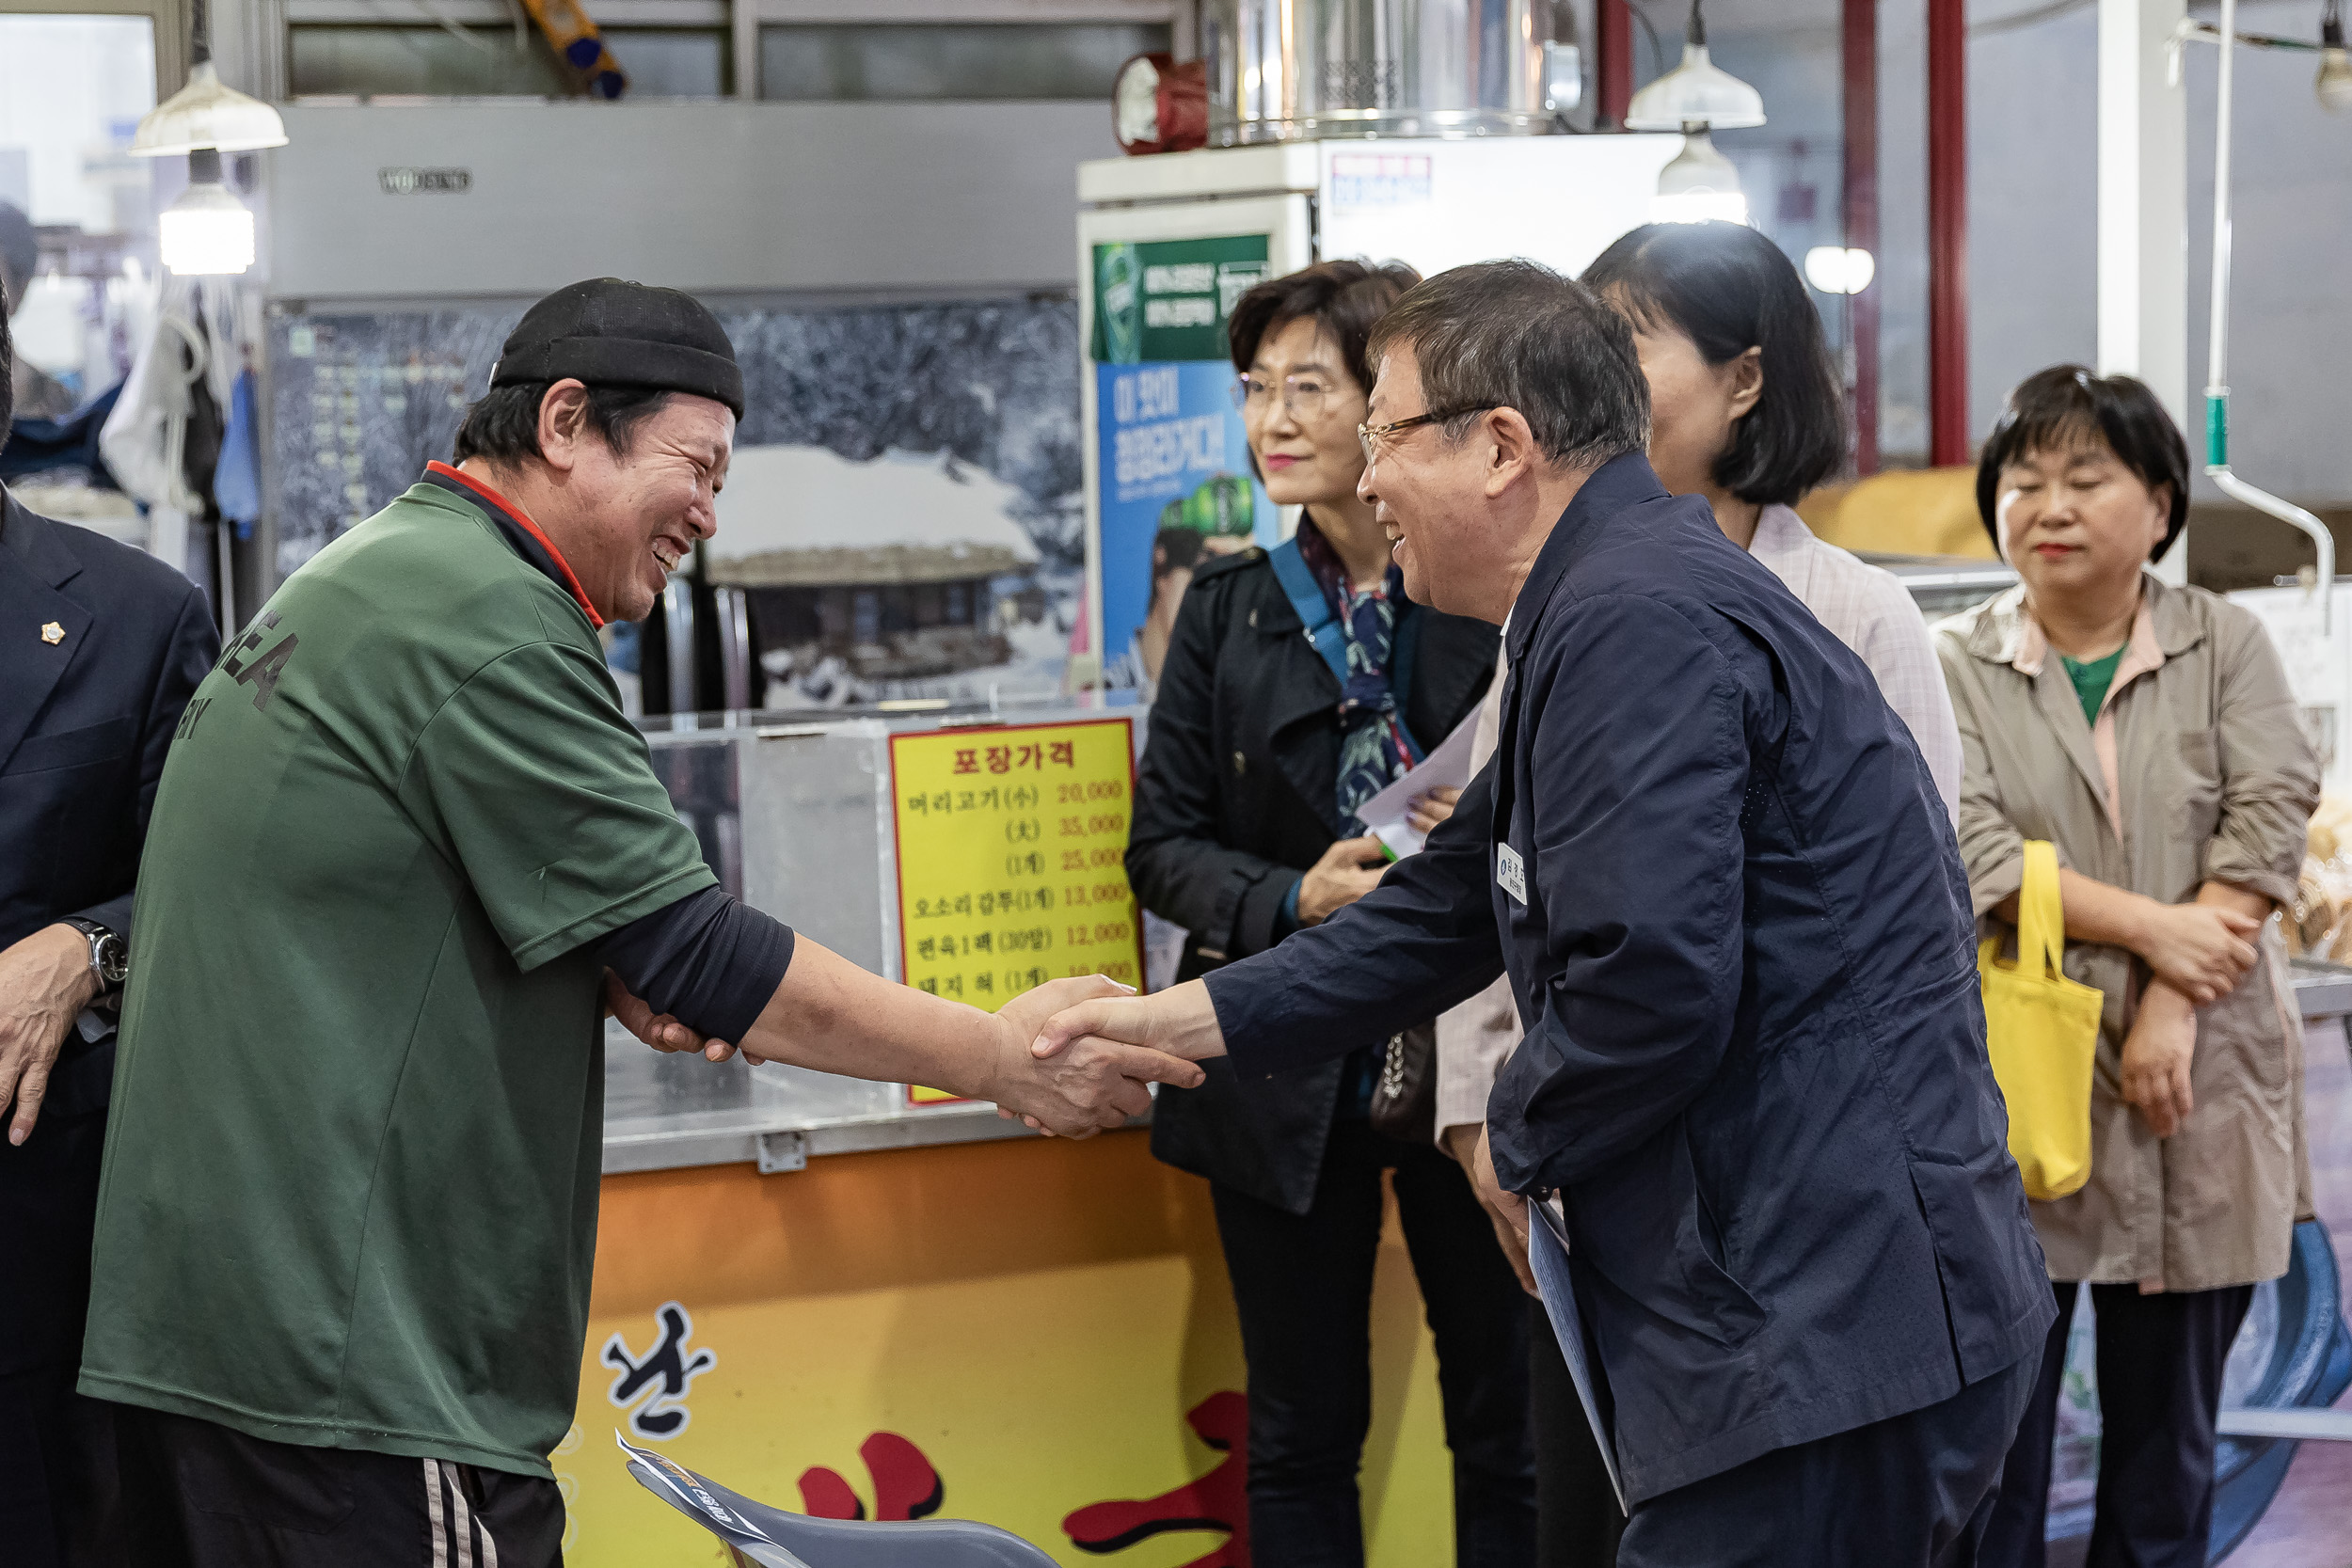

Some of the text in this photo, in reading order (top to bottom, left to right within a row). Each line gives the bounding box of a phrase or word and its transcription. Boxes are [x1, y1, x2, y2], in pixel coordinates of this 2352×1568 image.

[952, 738, 1074, 775] 포장가격
[1057, 779, 1124, 804] 20,000
[1067, 921, 1131, 947] 12,000
